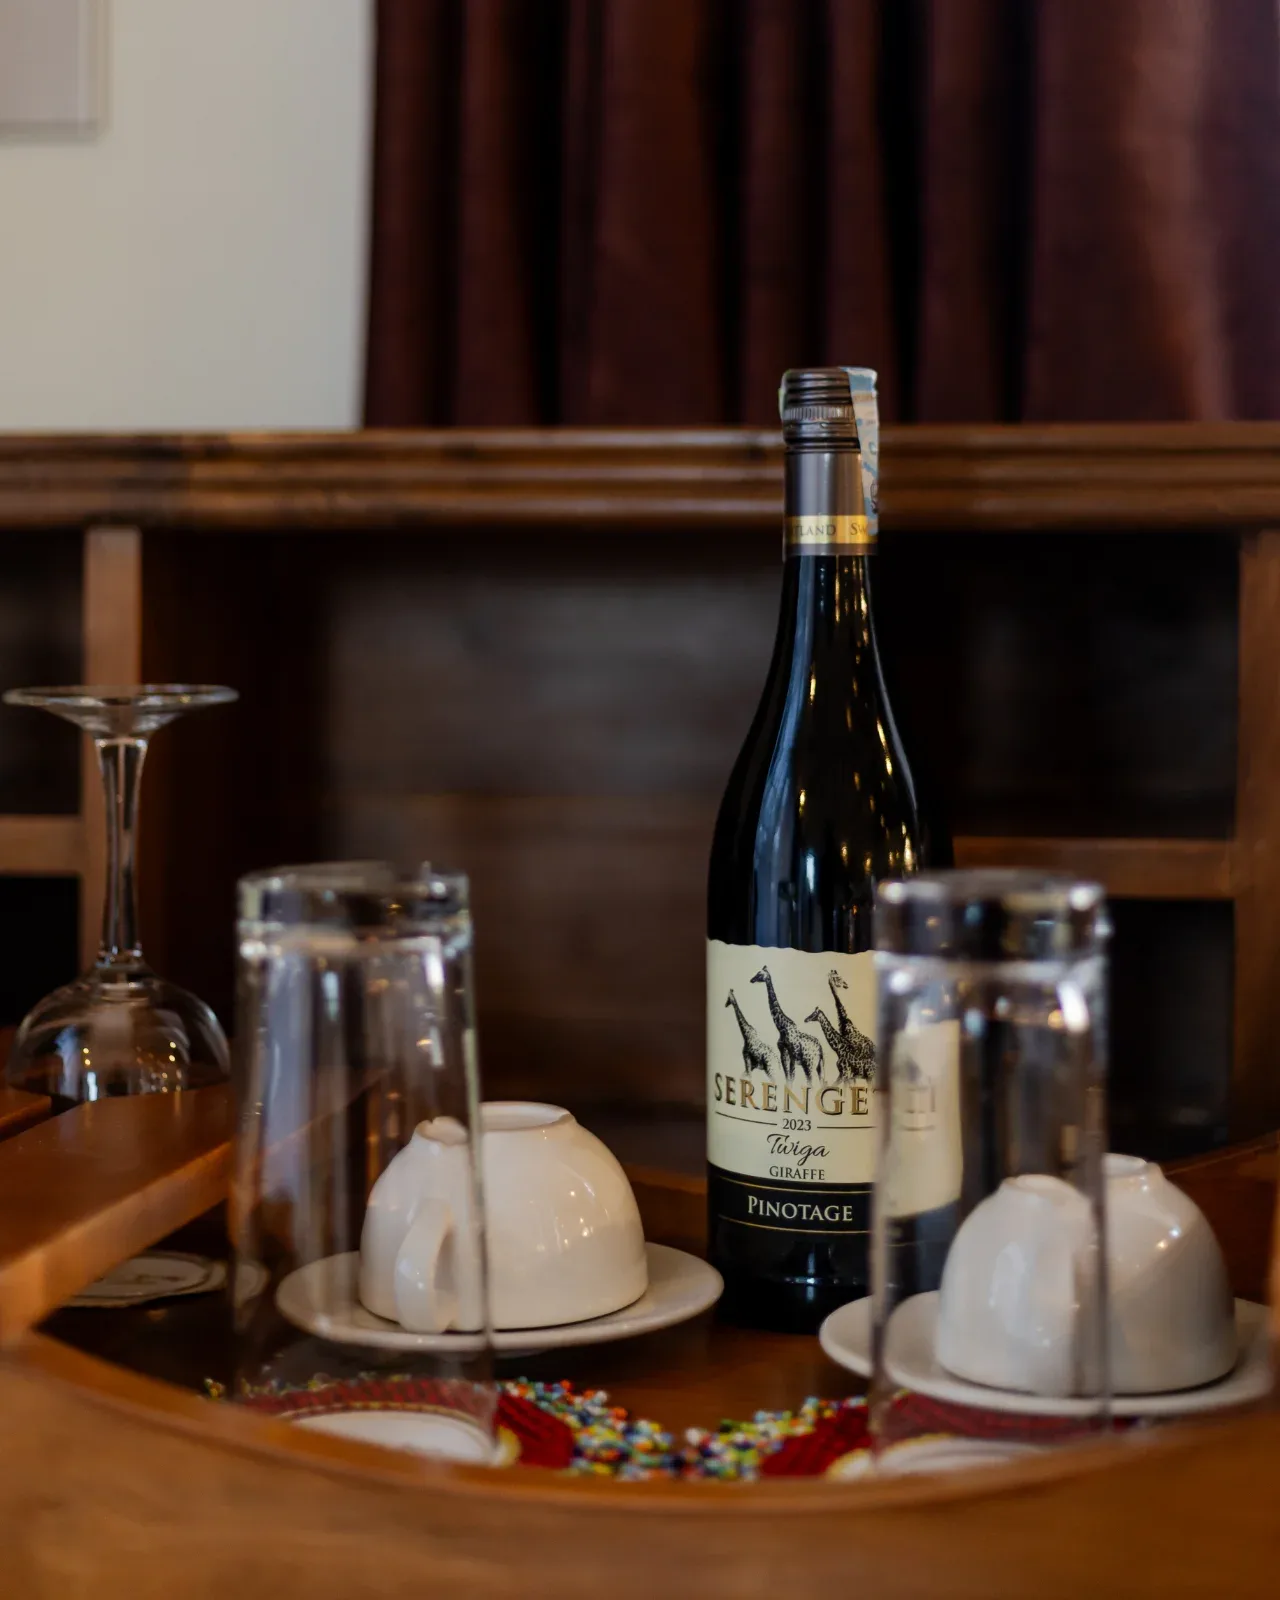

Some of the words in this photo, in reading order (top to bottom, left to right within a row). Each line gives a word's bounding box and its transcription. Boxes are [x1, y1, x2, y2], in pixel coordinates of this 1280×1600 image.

[714, 1072, 936, 1116] SERENGE
[782, 1119, 812, 1131] 2023
[766, 1133, 829, 1166] Twiga
[769, 1165, 825, 1181] GIRAFFE
[747, 1195, 853, 1222] PINOTAGE
